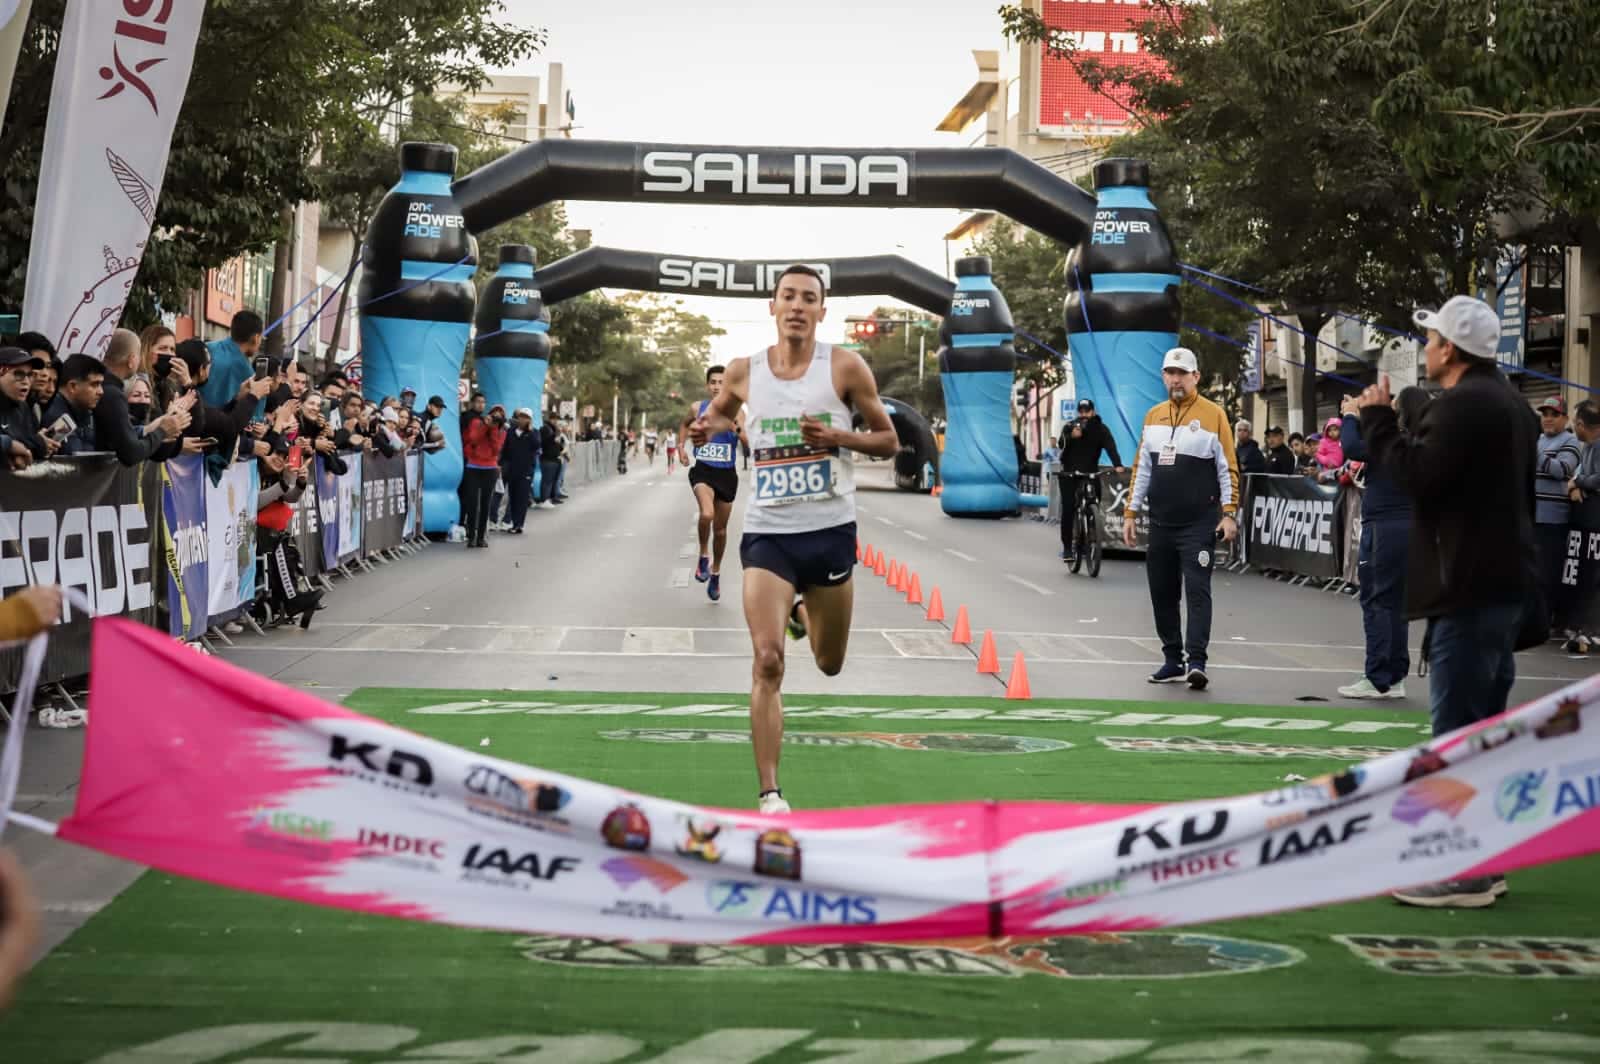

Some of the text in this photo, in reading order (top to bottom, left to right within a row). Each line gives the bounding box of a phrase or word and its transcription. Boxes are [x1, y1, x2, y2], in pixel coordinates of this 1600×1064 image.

[643, 151, 909, 196] SALIDA
[404, 224, 441, 239] ADE
[406, 212, 465, 229] POWER
[1092, 220, 1151, 234] POWER
[1091, 232, 1126, 245] ADE
[503, 288, 541, 299] POWER
[952, 298, 990, 308] POWER
[758, 463, 825, 498] 2986
[1553, 776, 1600, 816] AI
[357, 828, 446, 859] IMDEC
[1258, 812, 1373, 866] IAAF
[460, 843, 582, 881] IAAF
[763, 887, 878, 924] AIMS
